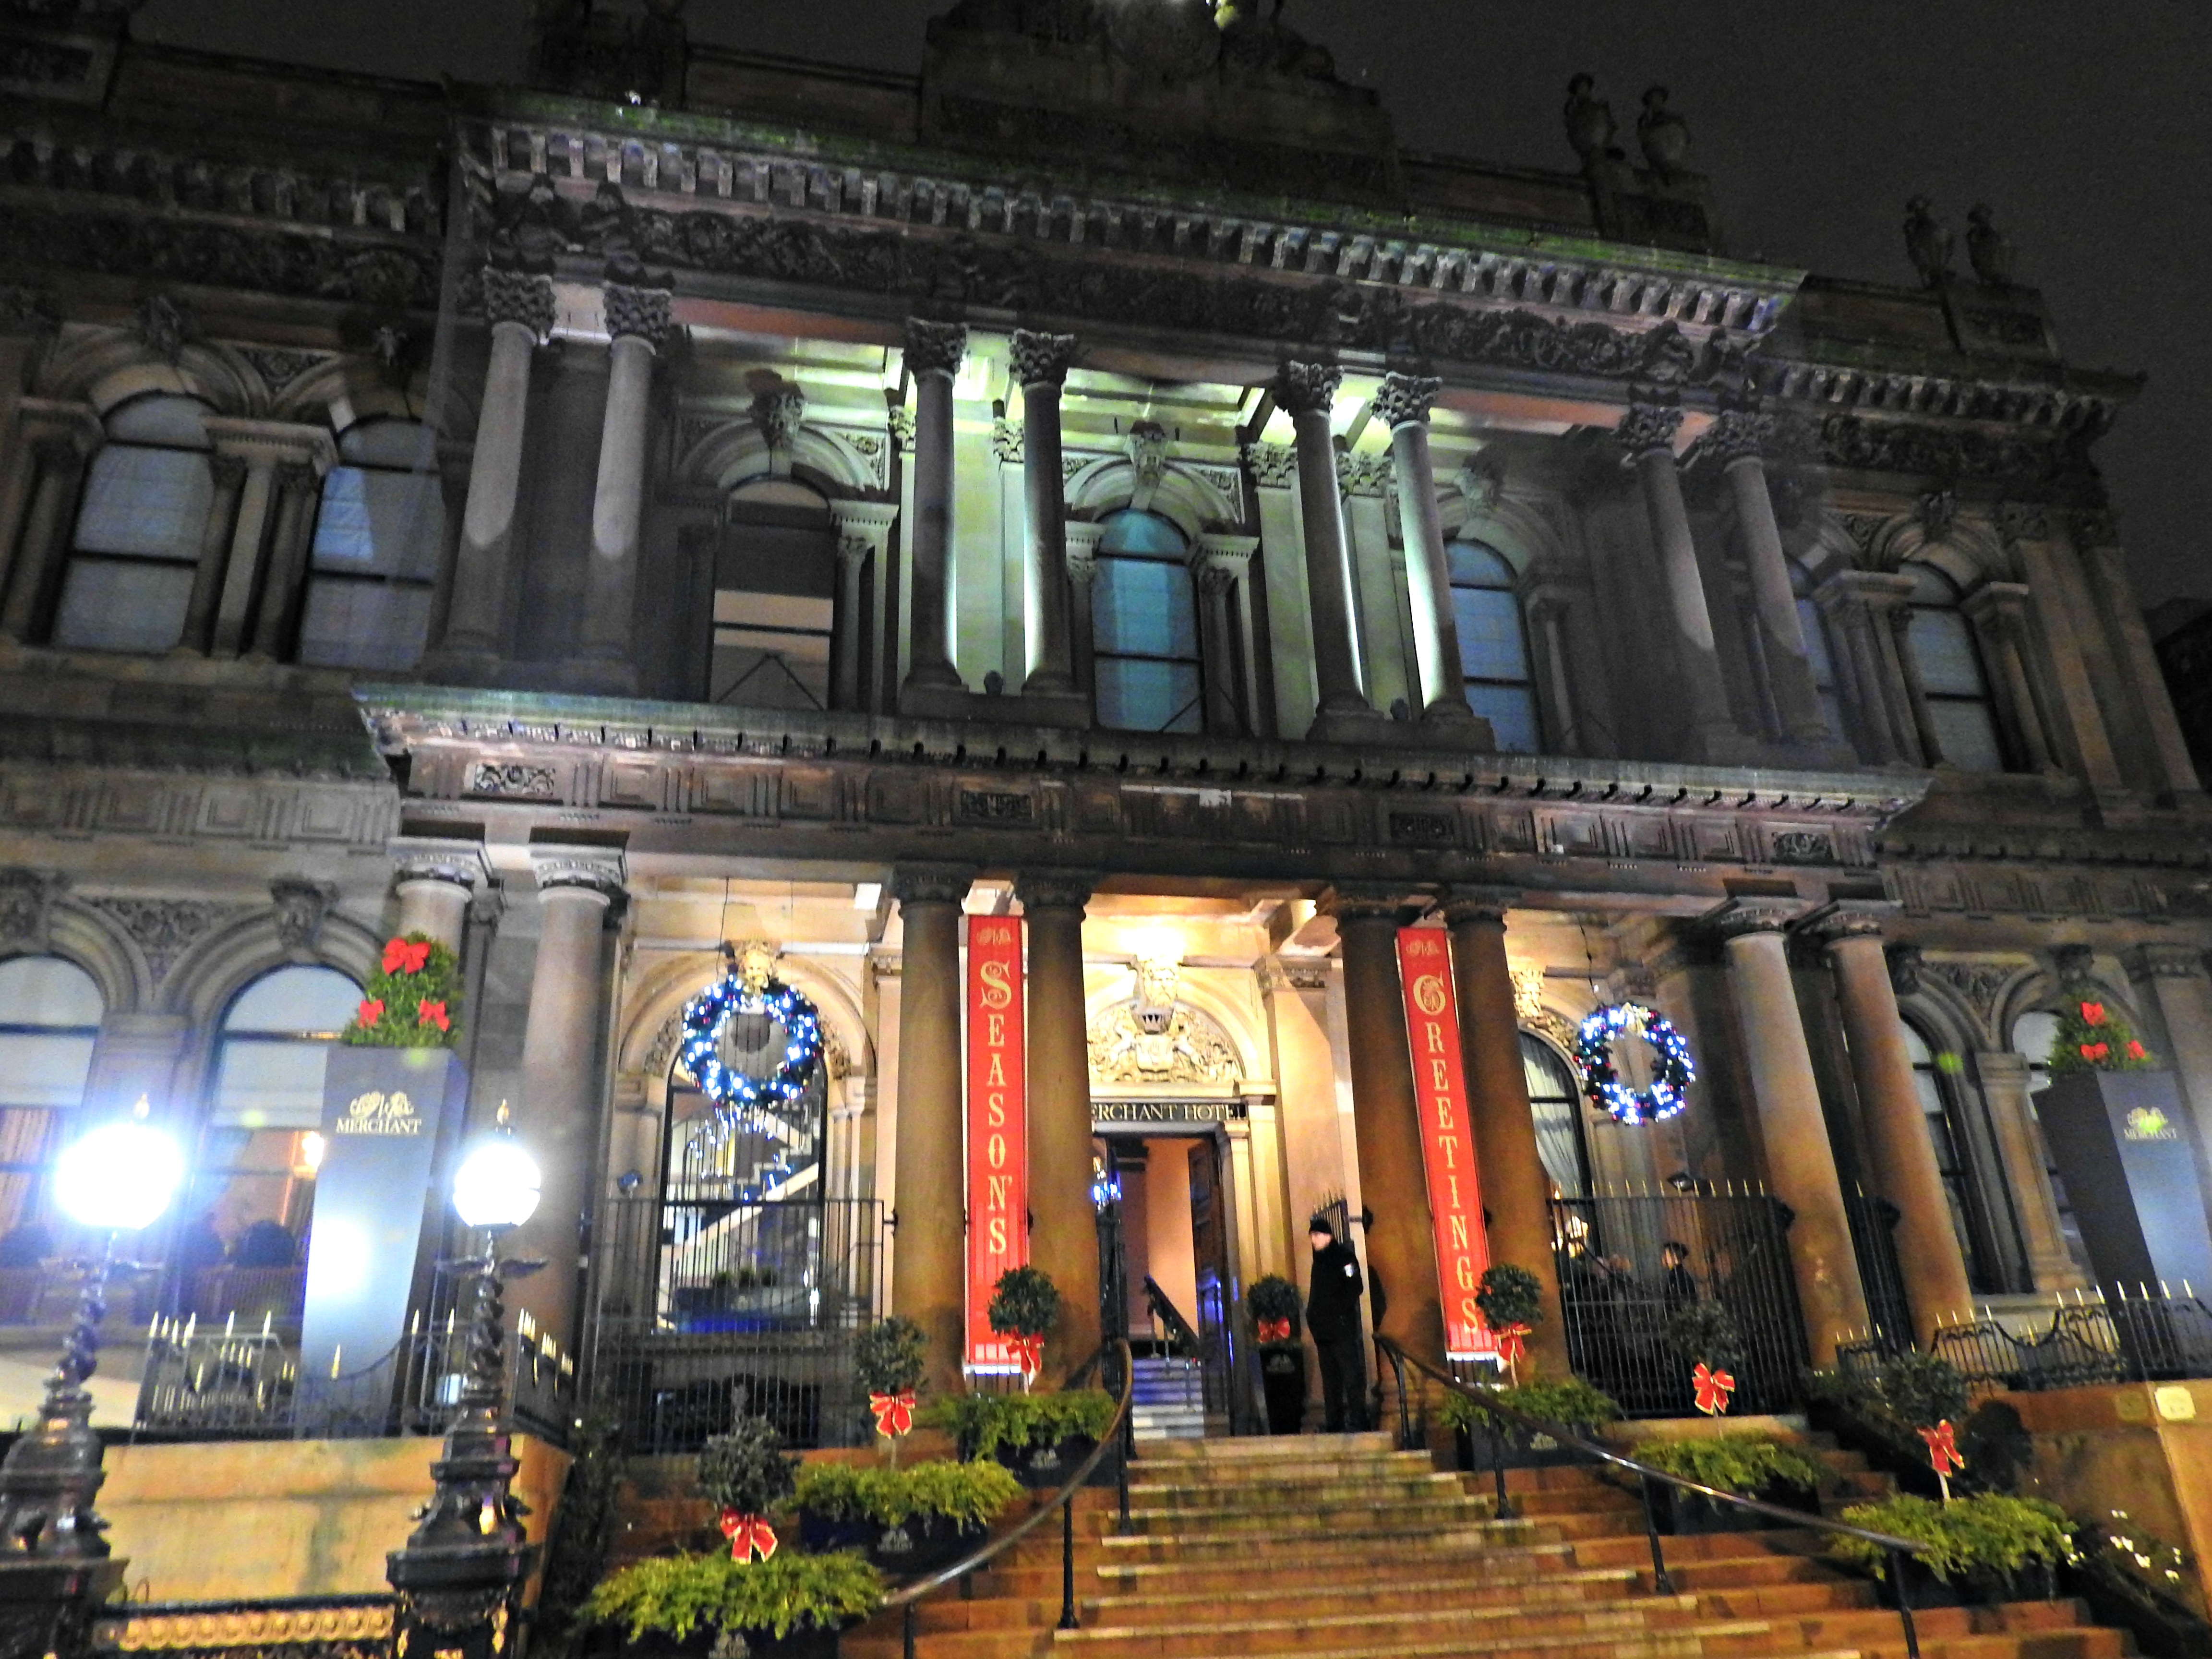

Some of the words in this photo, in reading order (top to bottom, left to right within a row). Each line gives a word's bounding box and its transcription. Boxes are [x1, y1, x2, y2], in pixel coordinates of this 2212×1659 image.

[337, 1118, 421, 1134] MERCHANT
[980, 961, 1012, 1255] SEASON'S
[1184, 1105, 1247, 1121] HOTEL
[1413, 974, 1479, 1333] GREETINGS
